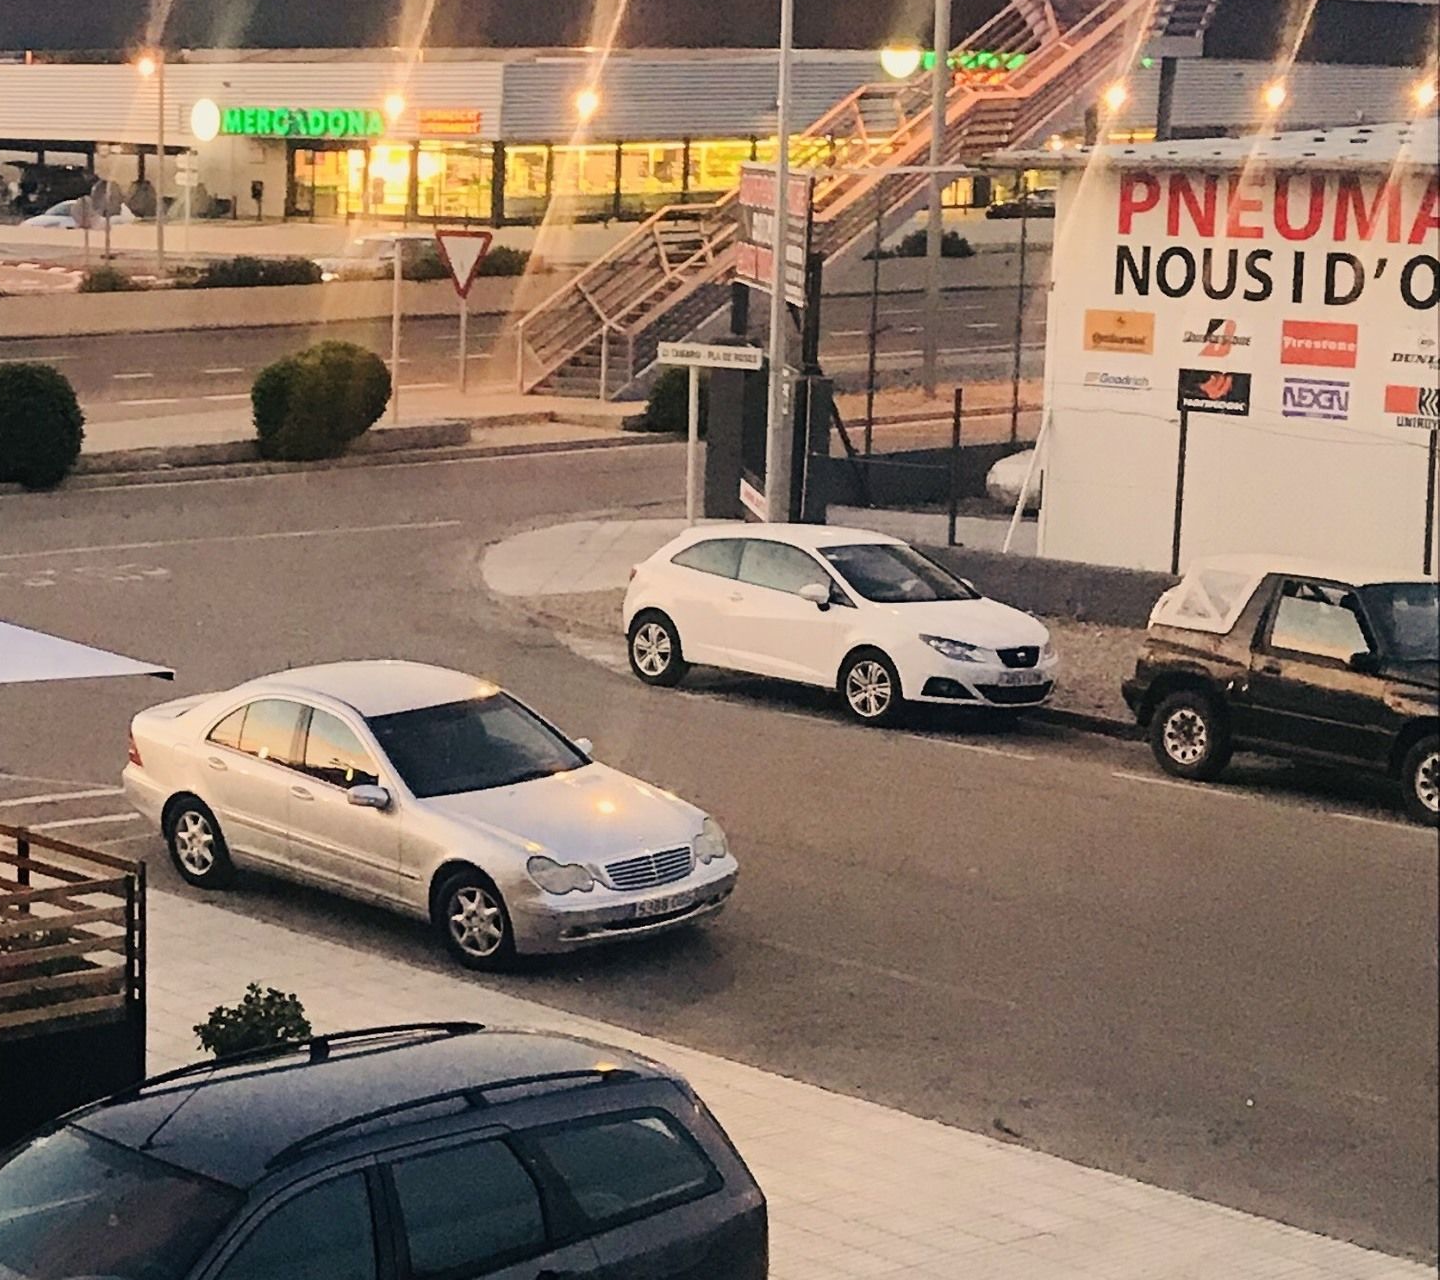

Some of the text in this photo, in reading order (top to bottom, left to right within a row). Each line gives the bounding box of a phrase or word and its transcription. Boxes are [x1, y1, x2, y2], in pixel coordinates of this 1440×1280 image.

[222, 107, 383, 137] MERCADONA
[1114, 245, 1273, 302] NOUS
[1291, 250, 1306, 304] I
[1283, 335, 1357, 352] Firestone
[1391, 353, 1440, 364] DUNL
